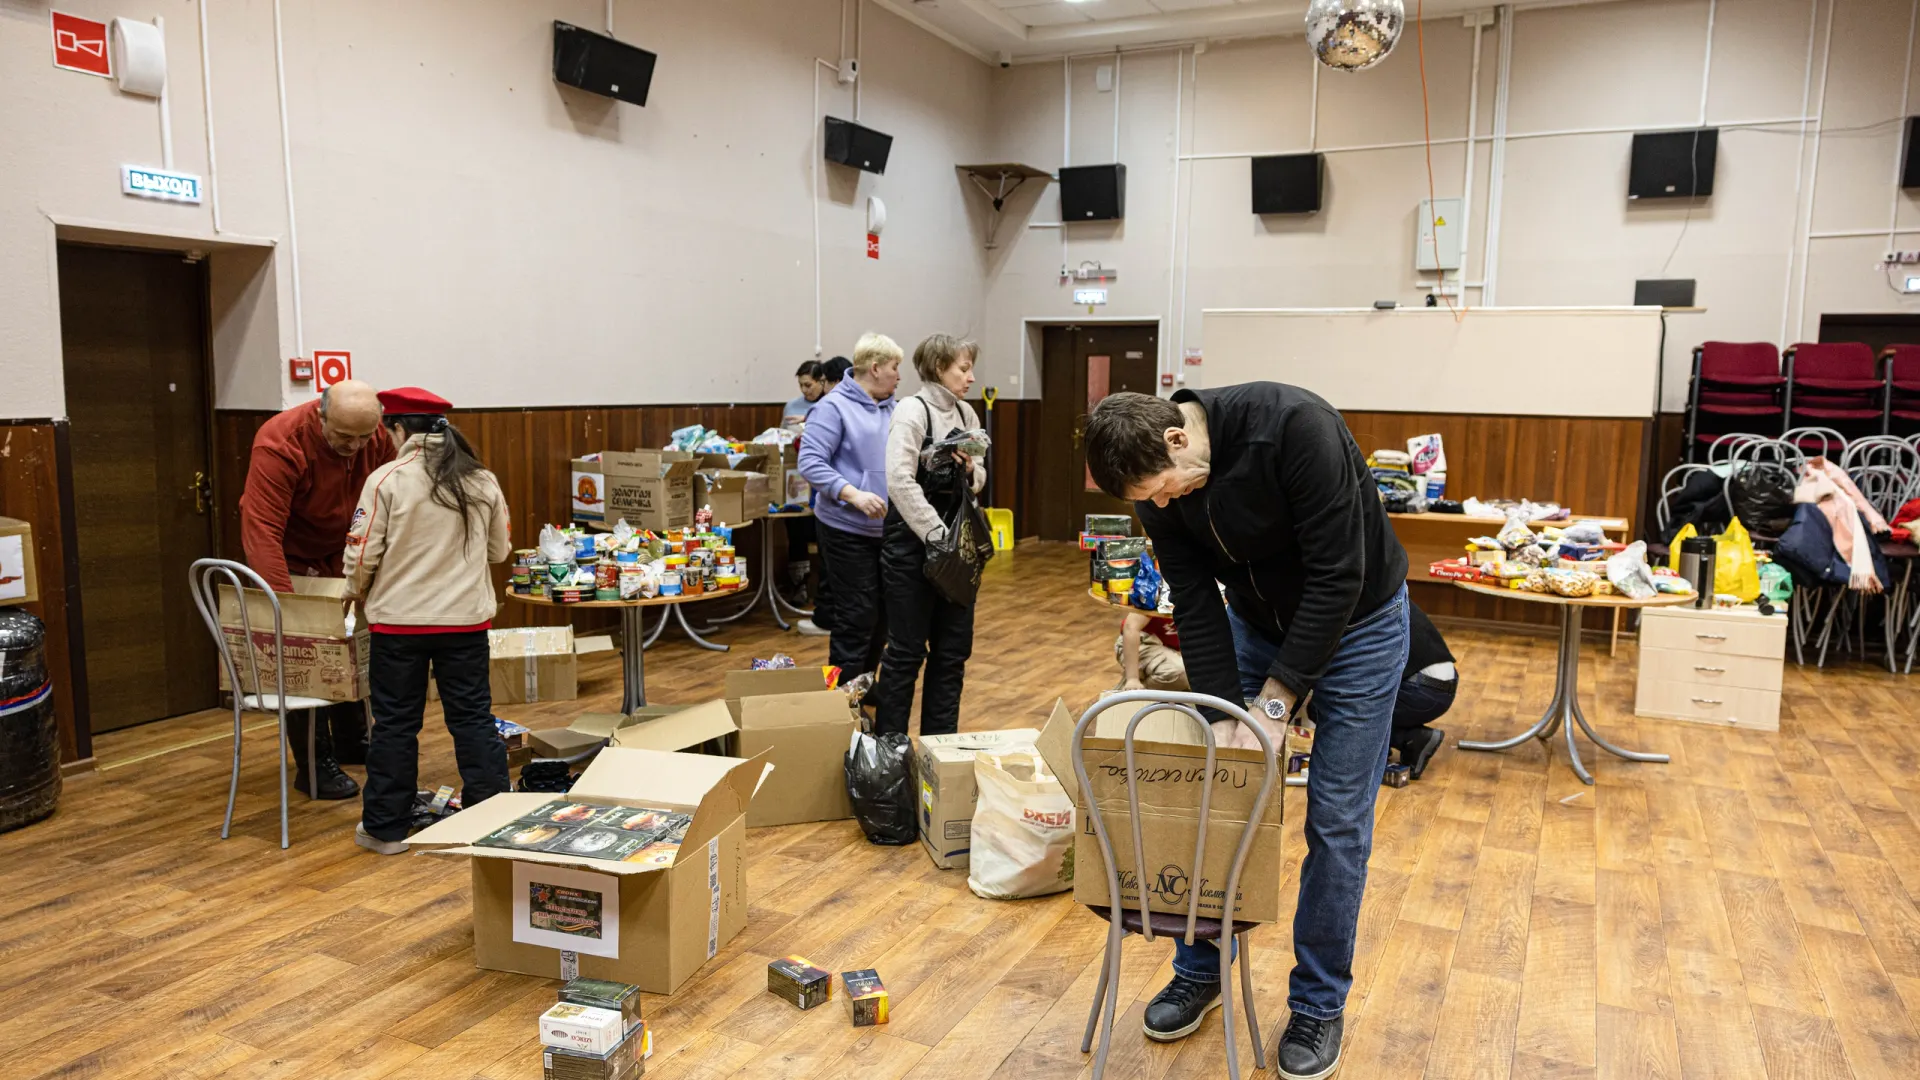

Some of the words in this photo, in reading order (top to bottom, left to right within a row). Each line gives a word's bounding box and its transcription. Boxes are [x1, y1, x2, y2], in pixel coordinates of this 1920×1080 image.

[131, 171, 194, 197] ВЫХОД
[611, 487, 652, 499] ЗОЛОТАЯ
[611, 497, 652, 508] СЕМЕЧКА
[263, 643, 317, 660] КЭШБМ!
